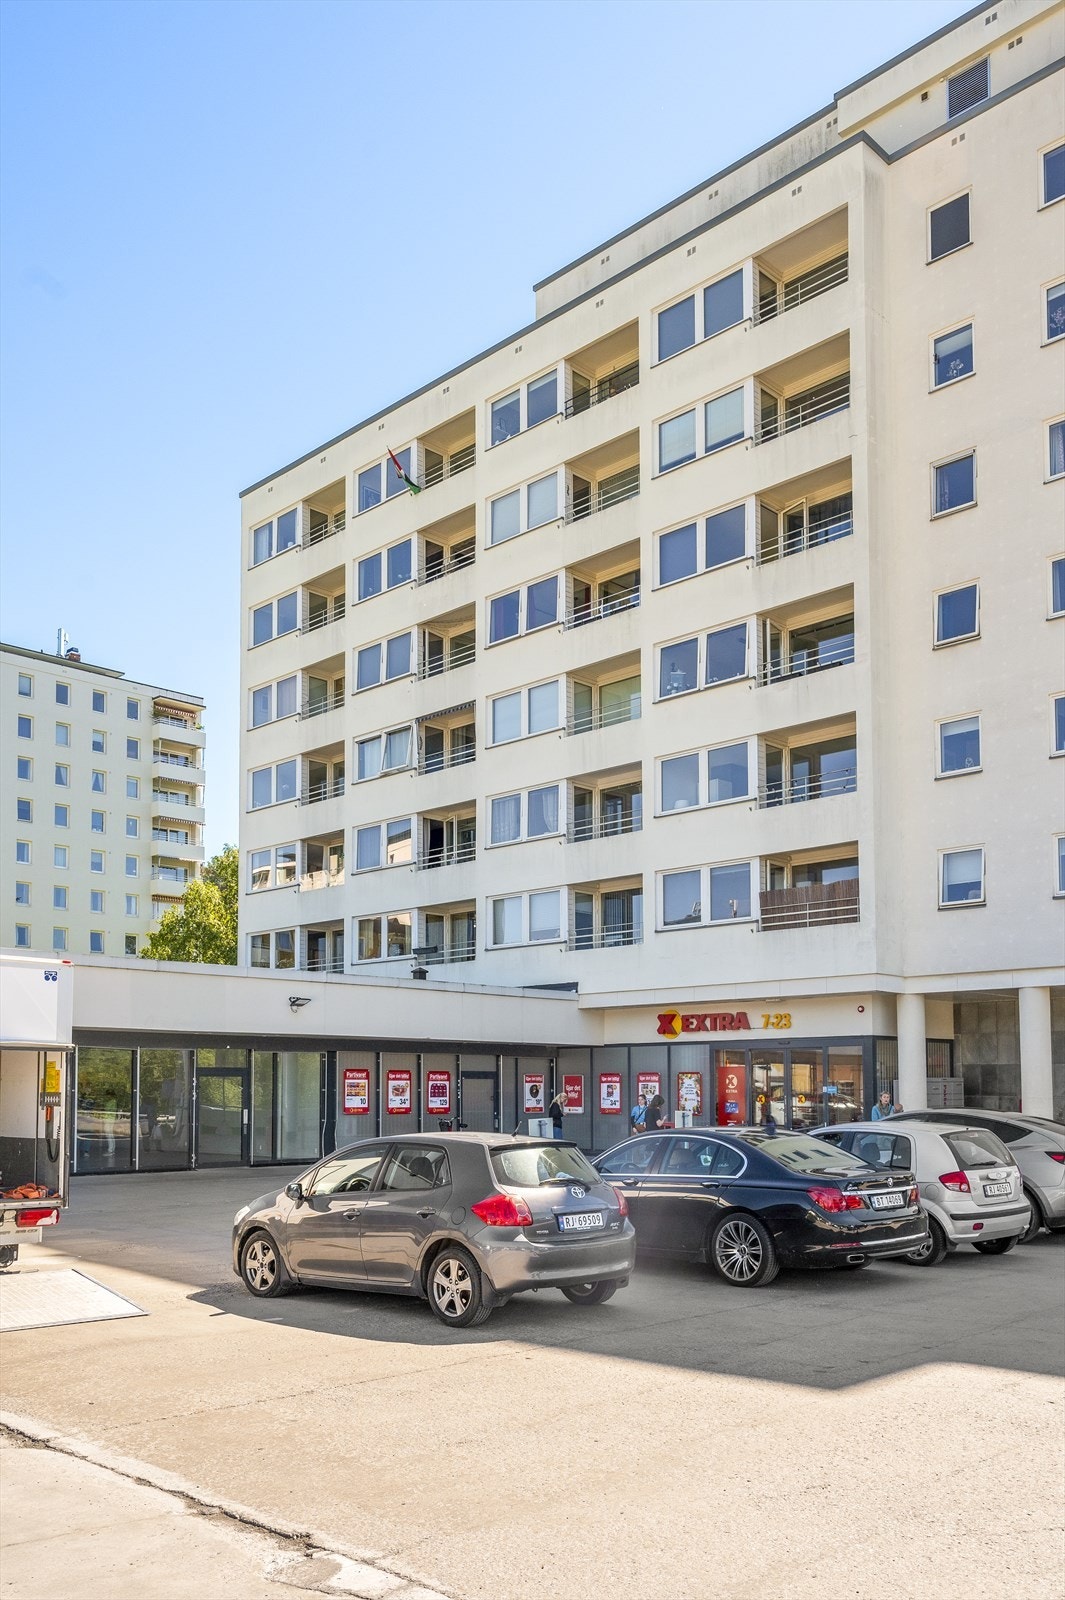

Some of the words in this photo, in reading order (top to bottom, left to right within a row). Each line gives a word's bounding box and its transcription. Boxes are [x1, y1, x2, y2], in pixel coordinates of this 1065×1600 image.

[681, 1011, 751, 1033] EXTRA
[761, 1013, 792, 1030] 7-23
[360, 1097, 367, 1105] 10
[876, 1196, 885, 1206] BT
[565, 1217, 575, 1228] RJ
[577, 1214, 601, 1226] 69509
